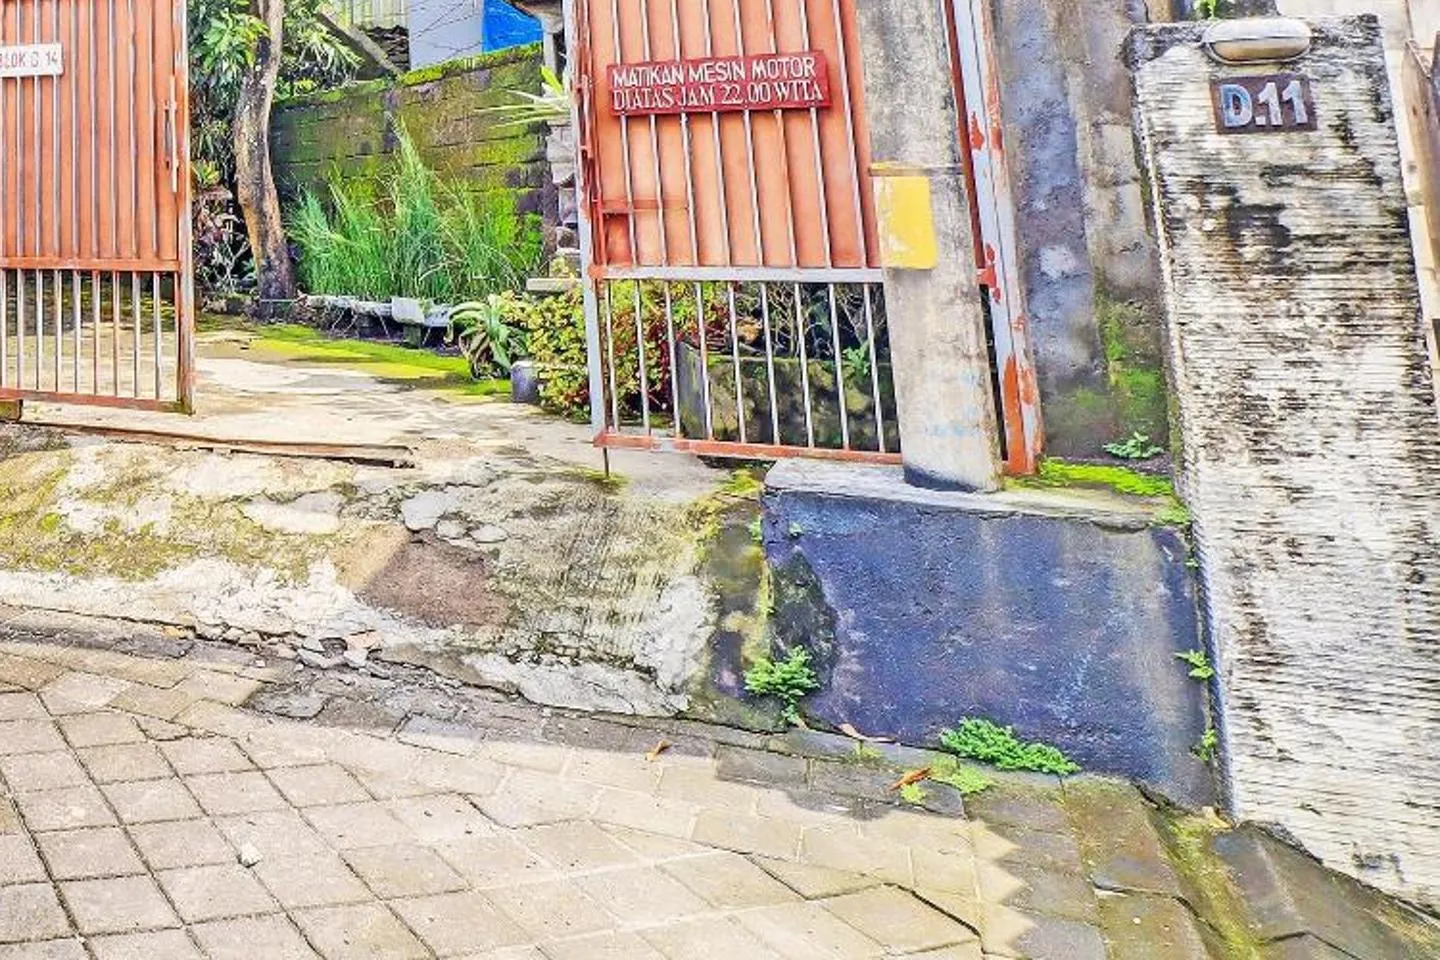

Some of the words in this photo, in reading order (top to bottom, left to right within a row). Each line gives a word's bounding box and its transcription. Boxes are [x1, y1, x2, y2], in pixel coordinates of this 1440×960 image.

[612, 64, 685, 89] MATIKAN
[688, 62, 746, 85] MESIN
[751, 57, 817, 80] MOTOR
[613, 87, 675, 111] DIATAS
[678, 85, 715, 107] JAM
[721, 83, 772, 105] 22.00
[775, 80, 824, 101] WITA
[1220, 79, 1309, 128] D.11
